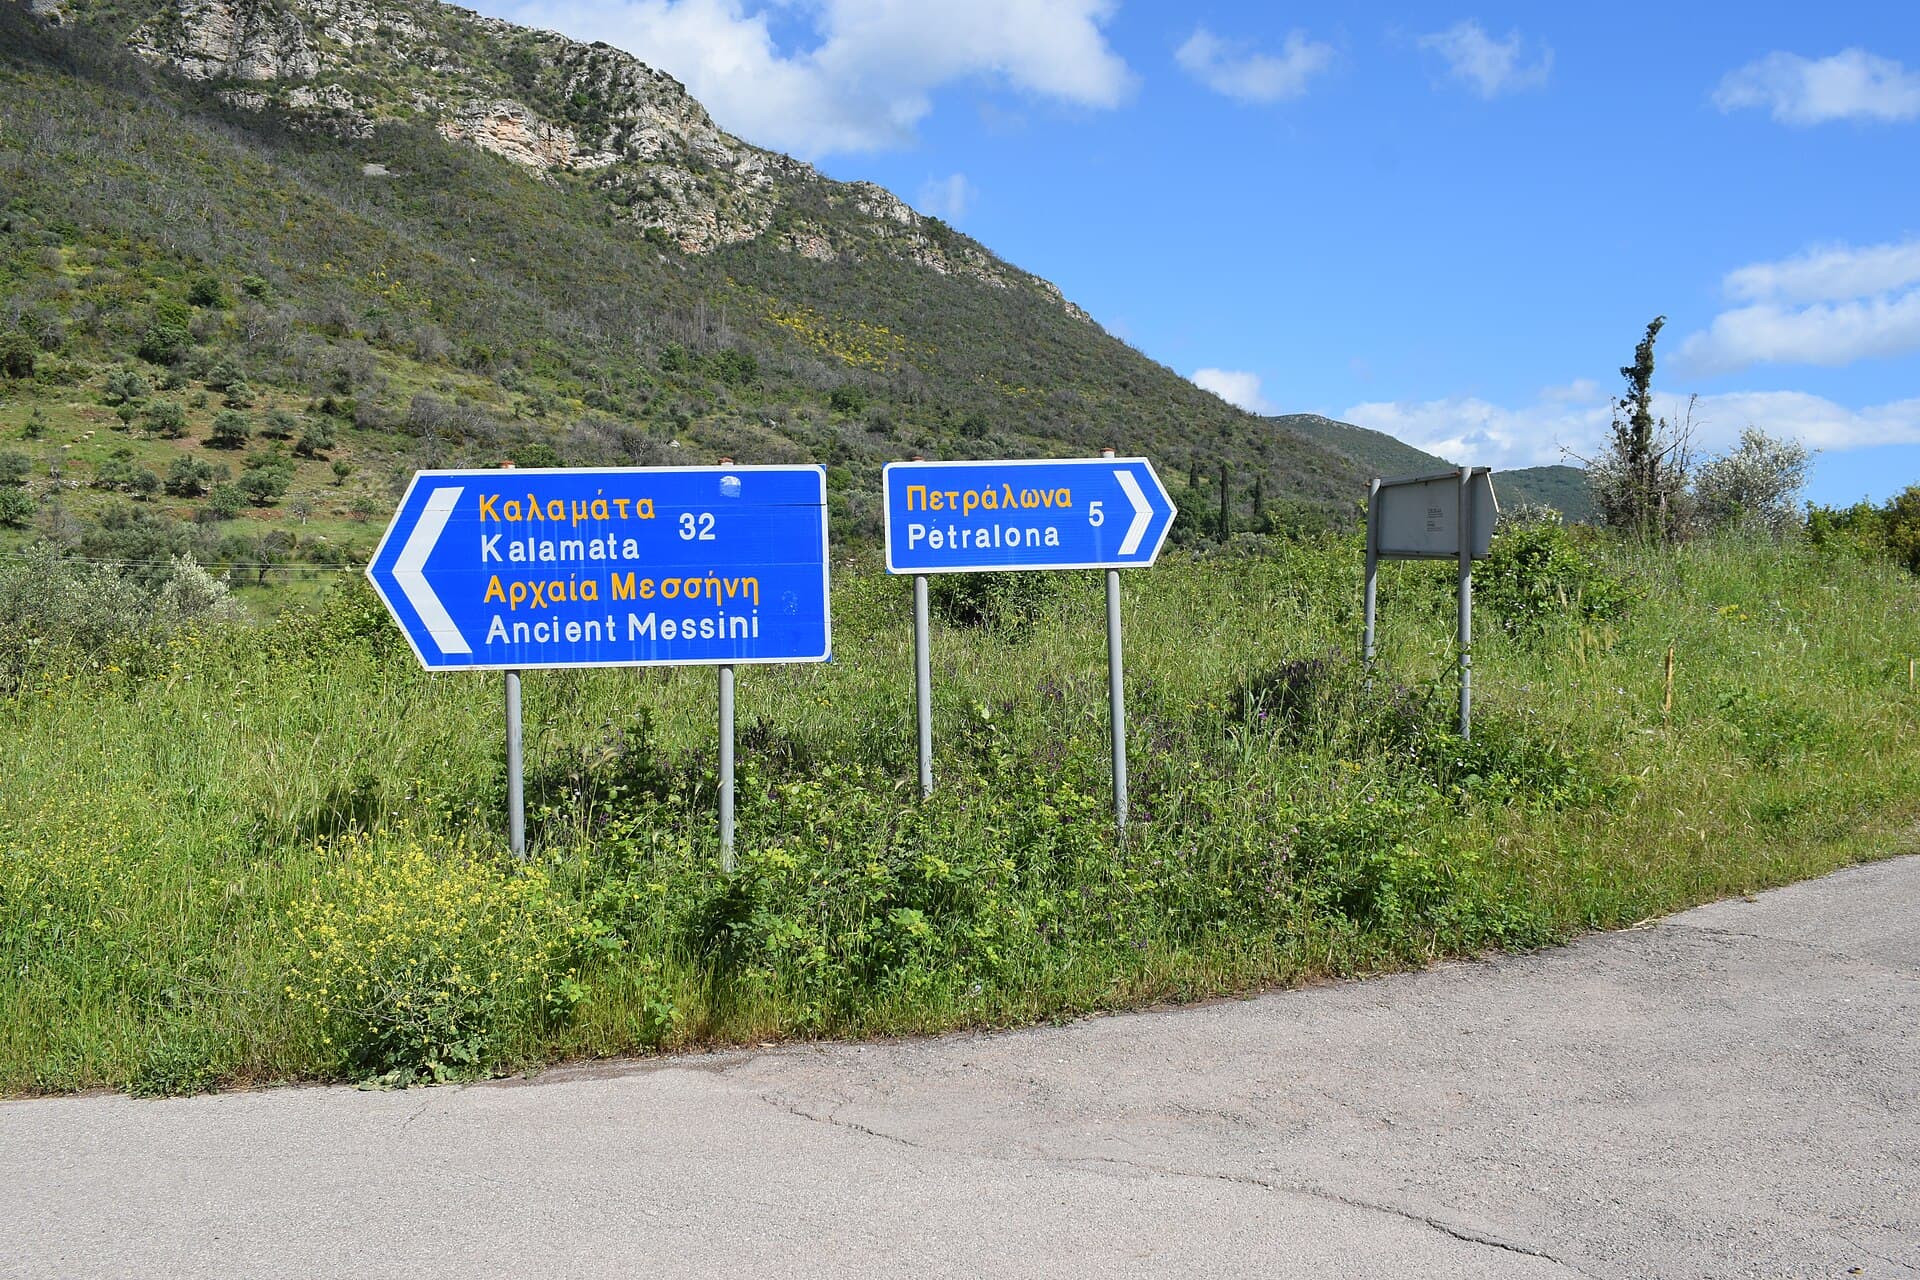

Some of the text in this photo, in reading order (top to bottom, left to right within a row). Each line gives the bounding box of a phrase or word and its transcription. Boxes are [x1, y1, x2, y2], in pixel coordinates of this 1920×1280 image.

[479, 489, 656, 527] Καλαμάτα
[906, 483, 1073, 517] Πετράλωνα
[1088, 500, 1105, 527] 5
[679, 512, 716, 541] 32
[481, 532, 640, 563] Kalamata
[483, 571, 759, 611] Αρχαία Μεσσήνη
[485, 608, 759, 645] Ancient Messini
